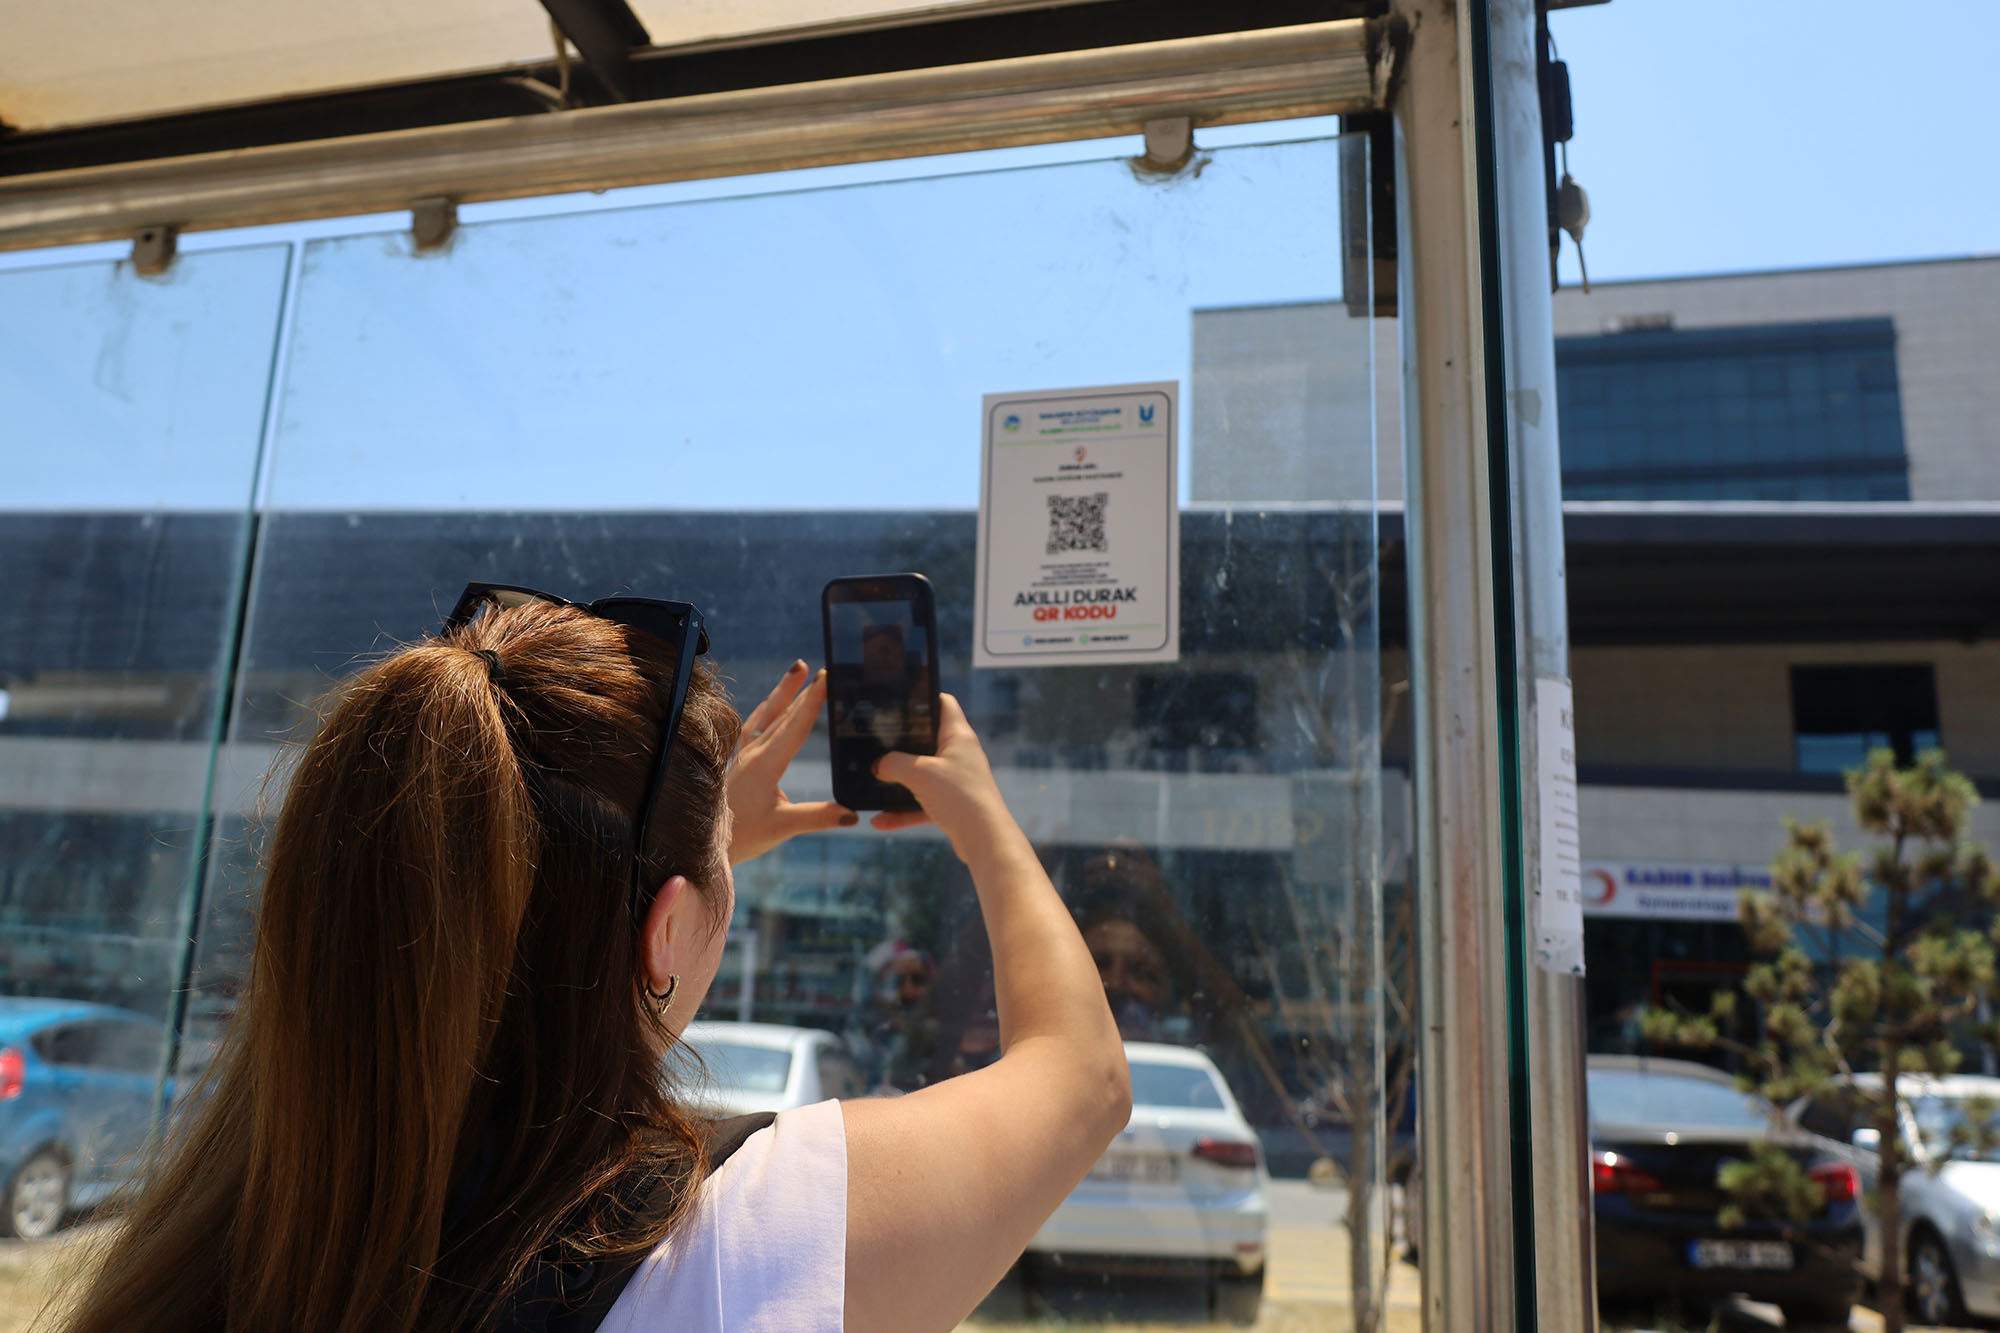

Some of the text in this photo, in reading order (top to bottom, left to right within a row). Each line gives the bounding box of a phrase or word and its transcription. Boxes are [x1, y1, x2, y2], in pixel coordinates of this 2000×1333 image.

[1014, 586, 1138, 606] AKILLI DURAK
[1033, 604, 1117, 622] QR KODU
